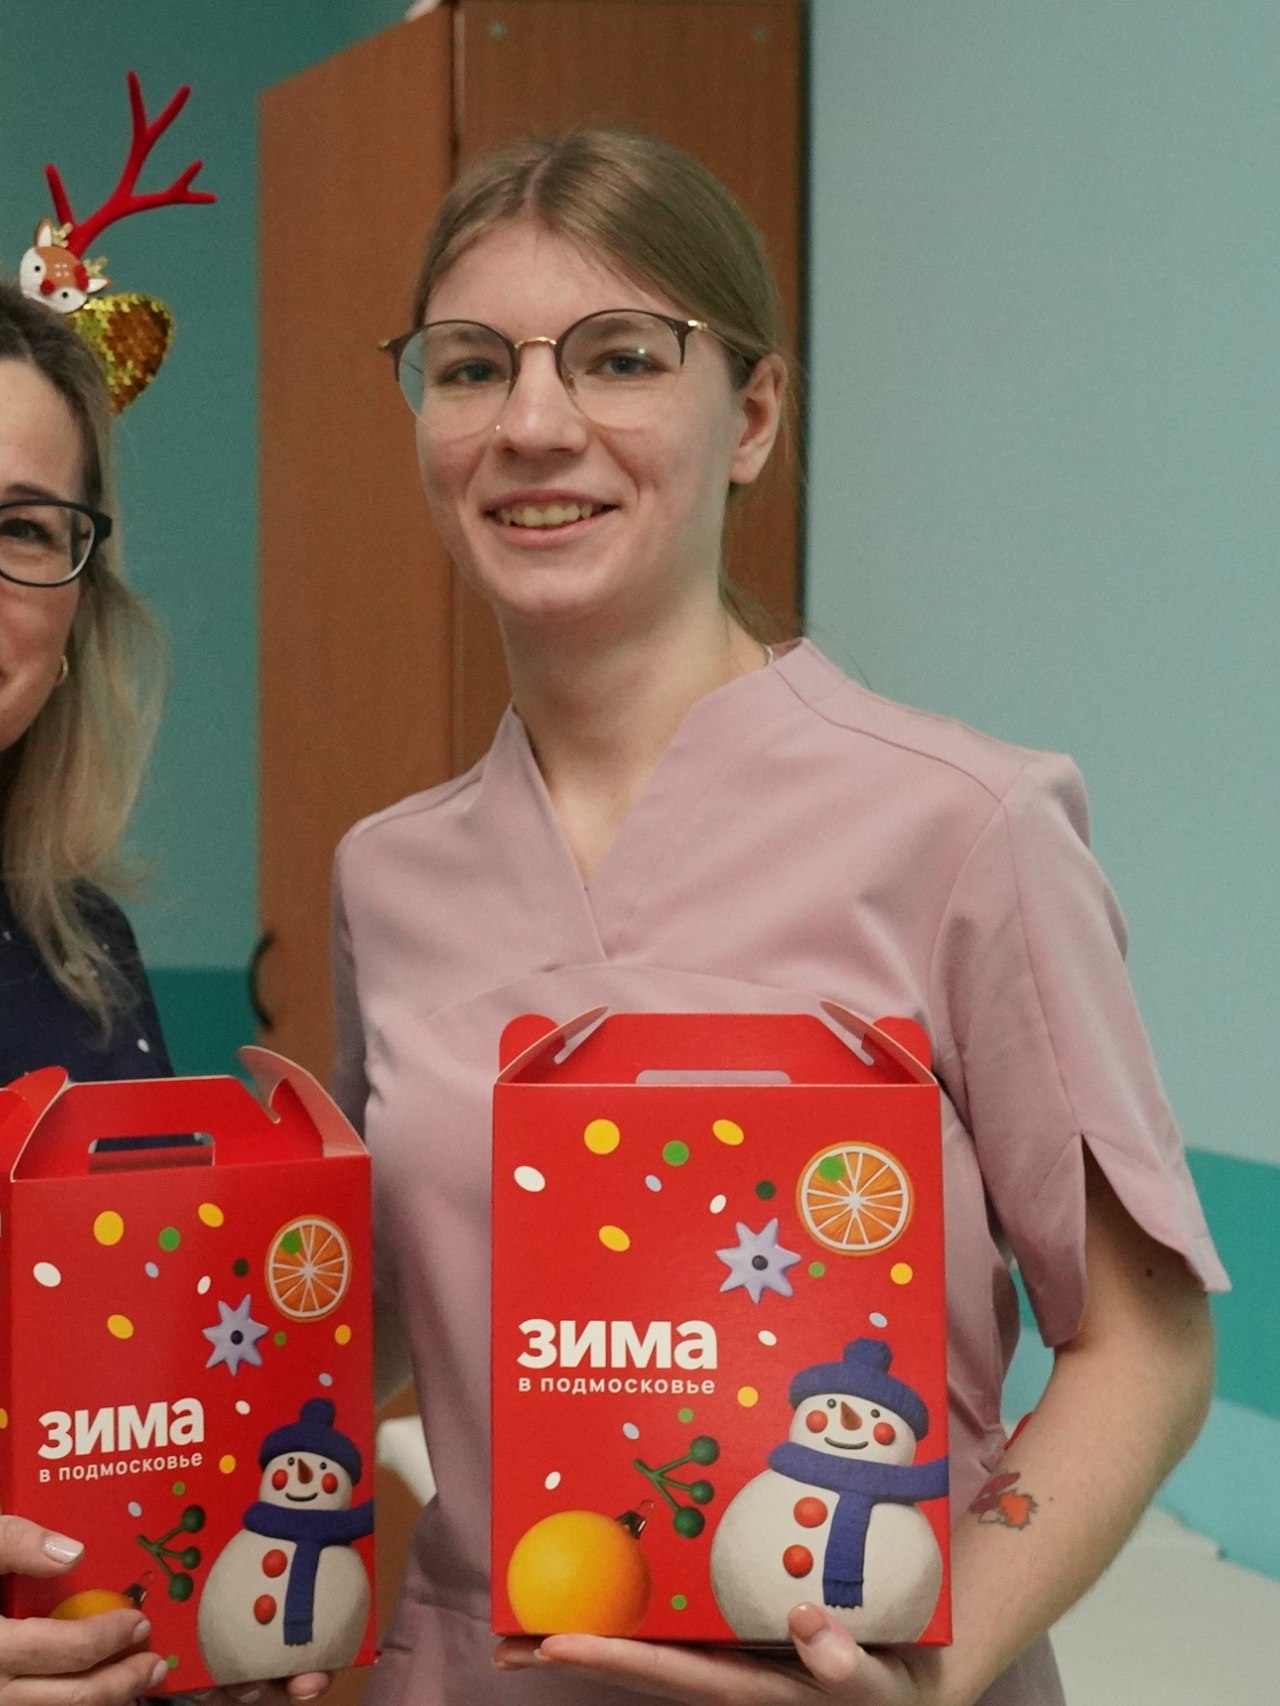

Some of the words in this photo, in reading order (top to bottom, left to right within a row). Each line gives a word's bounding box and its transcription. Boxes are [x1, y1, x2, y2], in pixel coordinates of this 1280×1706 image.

[518, 1377, 532, 1392] в
[540, 1377, 716, 1395] подмосковье
[39, 1468, 51, 1483] в
[58, 1452, 203, 1482] подмосковье
